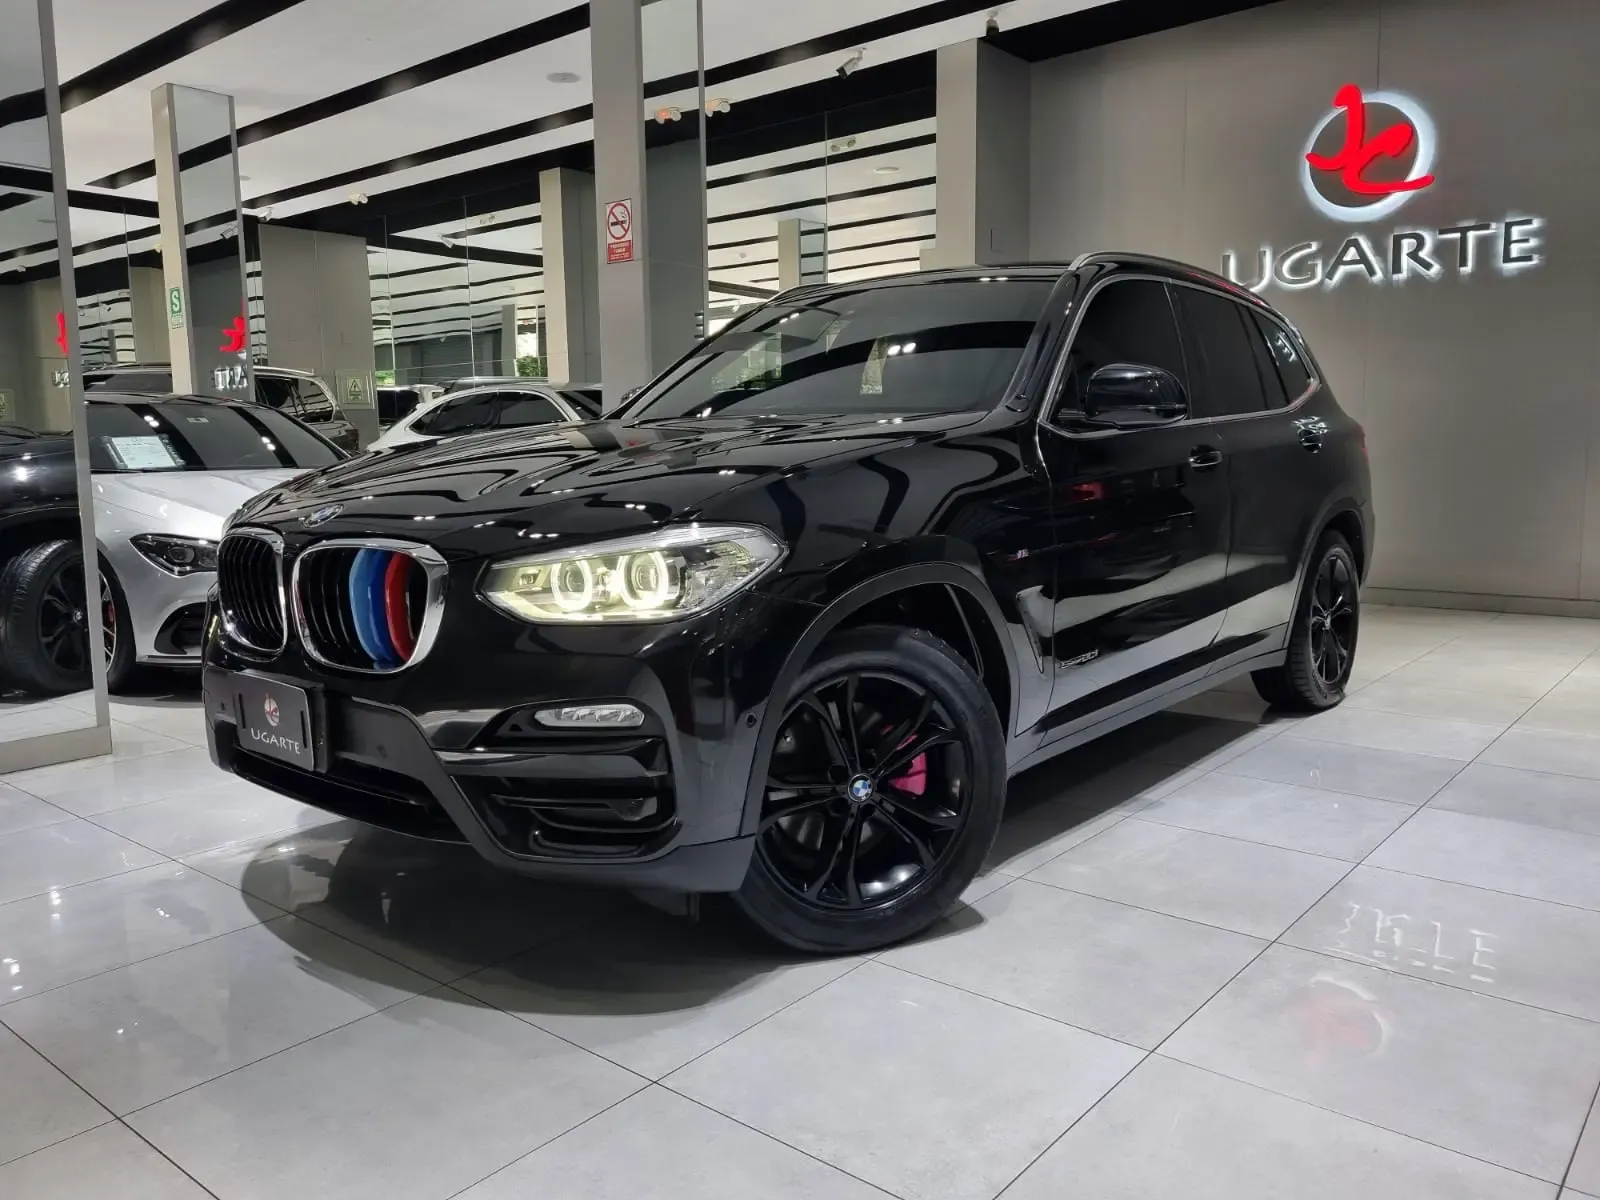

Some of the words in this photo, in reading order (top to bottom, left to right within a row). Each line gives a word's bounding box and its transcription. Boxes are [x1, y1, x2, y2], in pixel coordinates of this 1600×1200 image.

[1221, 216, 1546, 293] UGARTE
[171, 291, 181, 313] S
[250, 727, 301, 755] UGARTE
